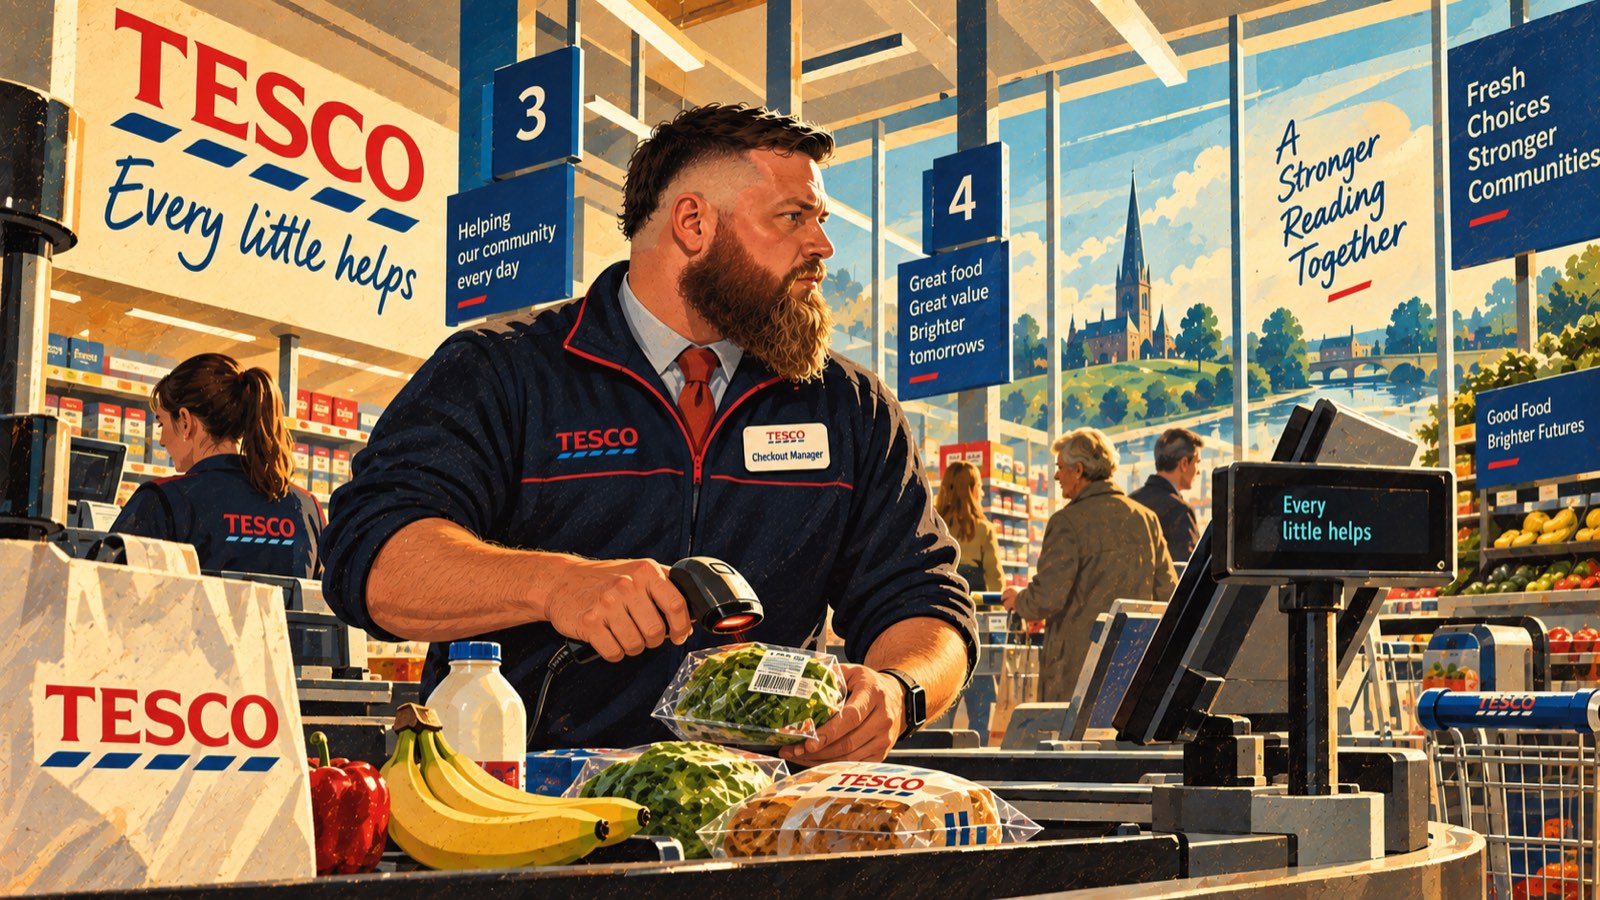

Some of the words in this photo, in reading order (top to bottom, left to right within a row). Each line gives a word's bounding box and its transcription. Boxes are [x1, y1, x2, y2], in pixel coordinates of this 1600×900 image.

[1468, 66, 1525, 107] Fresh
[115, 8, 424, 202] TESCO
[516, 85, 546, 141] 3
[1468, 95, 1551, 138] Choices
[1276, 119, 1301, 165] A
[1468, 125, 1557, 171] Stronger
[1277, 134, 1380, 203] Stronger
[1468, 147, 1600, 204] Communities
[948, 174, 977, 221] 4
[1280, 180, 1385, 247] Reading
[105, 155, 224, 272] Every
[240, 203, 326, 272] little
[335, 233, 417, 316] helps
[458, 212, 511, 241] Helping
[457, 247, 480, 265] our
[482, 224, 556, 258] community
[1288, 221, 1407, 289] Together
[457, 268, 493, 290] every
[496, 260, 520, 280] day
[910, 271, 948, 292] Great
[950, 258, 983, 282] food
[910, 294, 948, 317] Great
[951, 286, 989, 306] value
[910, 316, 966, 342] Brighter
[909, 338, 985, 366] tomorrows
[1487, 404, 1518, 425] Good
[1521, 397, 1551, 418] Food
[556, 427, 638, 451] TESCO
[766, 430, 805, 441] TESCO
[1488, 429, 1535, 451] Brighter
[1538, 420, 1585, 440] Futures
[752, 451, 788, 462] Checkout
[790, 450, 823, 462] Manager
[1283, 495, 1326, 519] Every
[224, 513, 295, 538] TESCO
[1283, 520, 1322, 541] little
[1328, 520, 1372, 546] helps
[46, 685, 279, 748] TESCO
[1478, 694, 1536, 709] TESCO
[838, 773, 925, 792] TESCO
